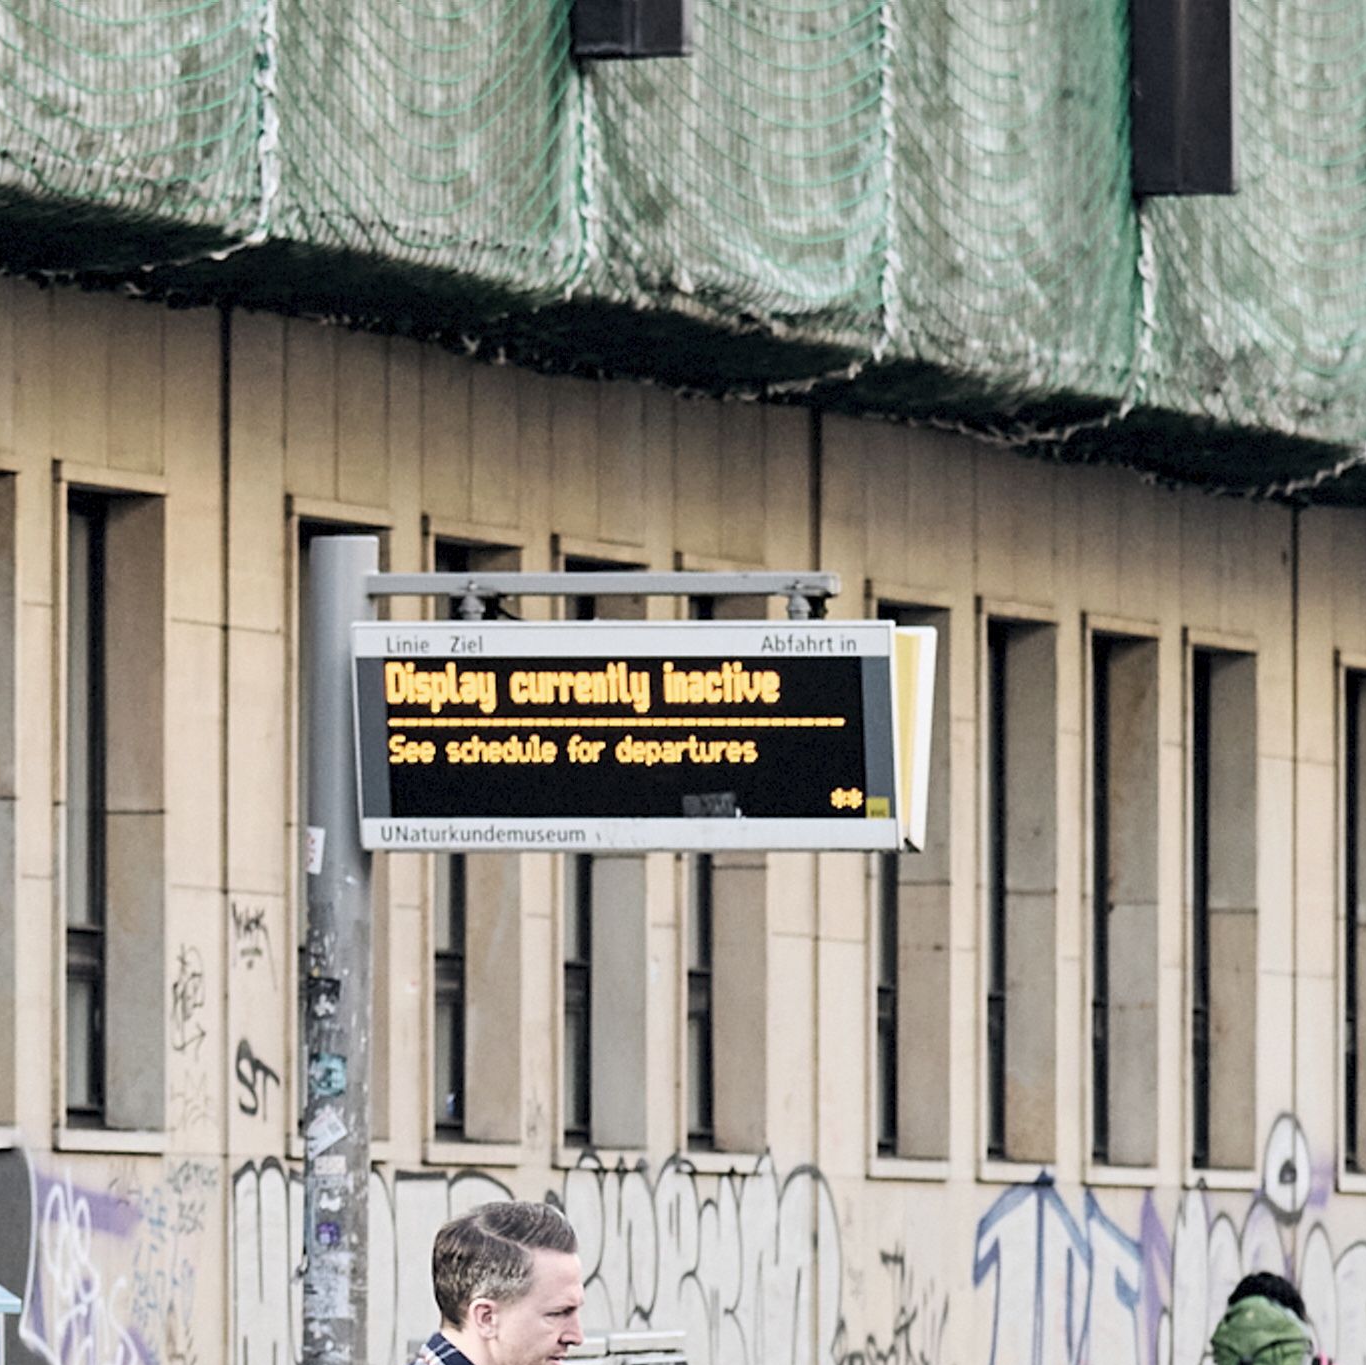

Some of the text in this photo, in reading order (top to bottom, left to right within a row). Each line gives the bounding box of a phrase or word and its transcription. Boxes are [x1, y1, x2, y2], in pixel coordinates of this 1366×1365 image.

[386, 634, 858, 654] Linie Ziel Abfahrt in
[384, 661, 780, 713] Display currently inactive
[389, 733, 758, 766] See schedule for departures
